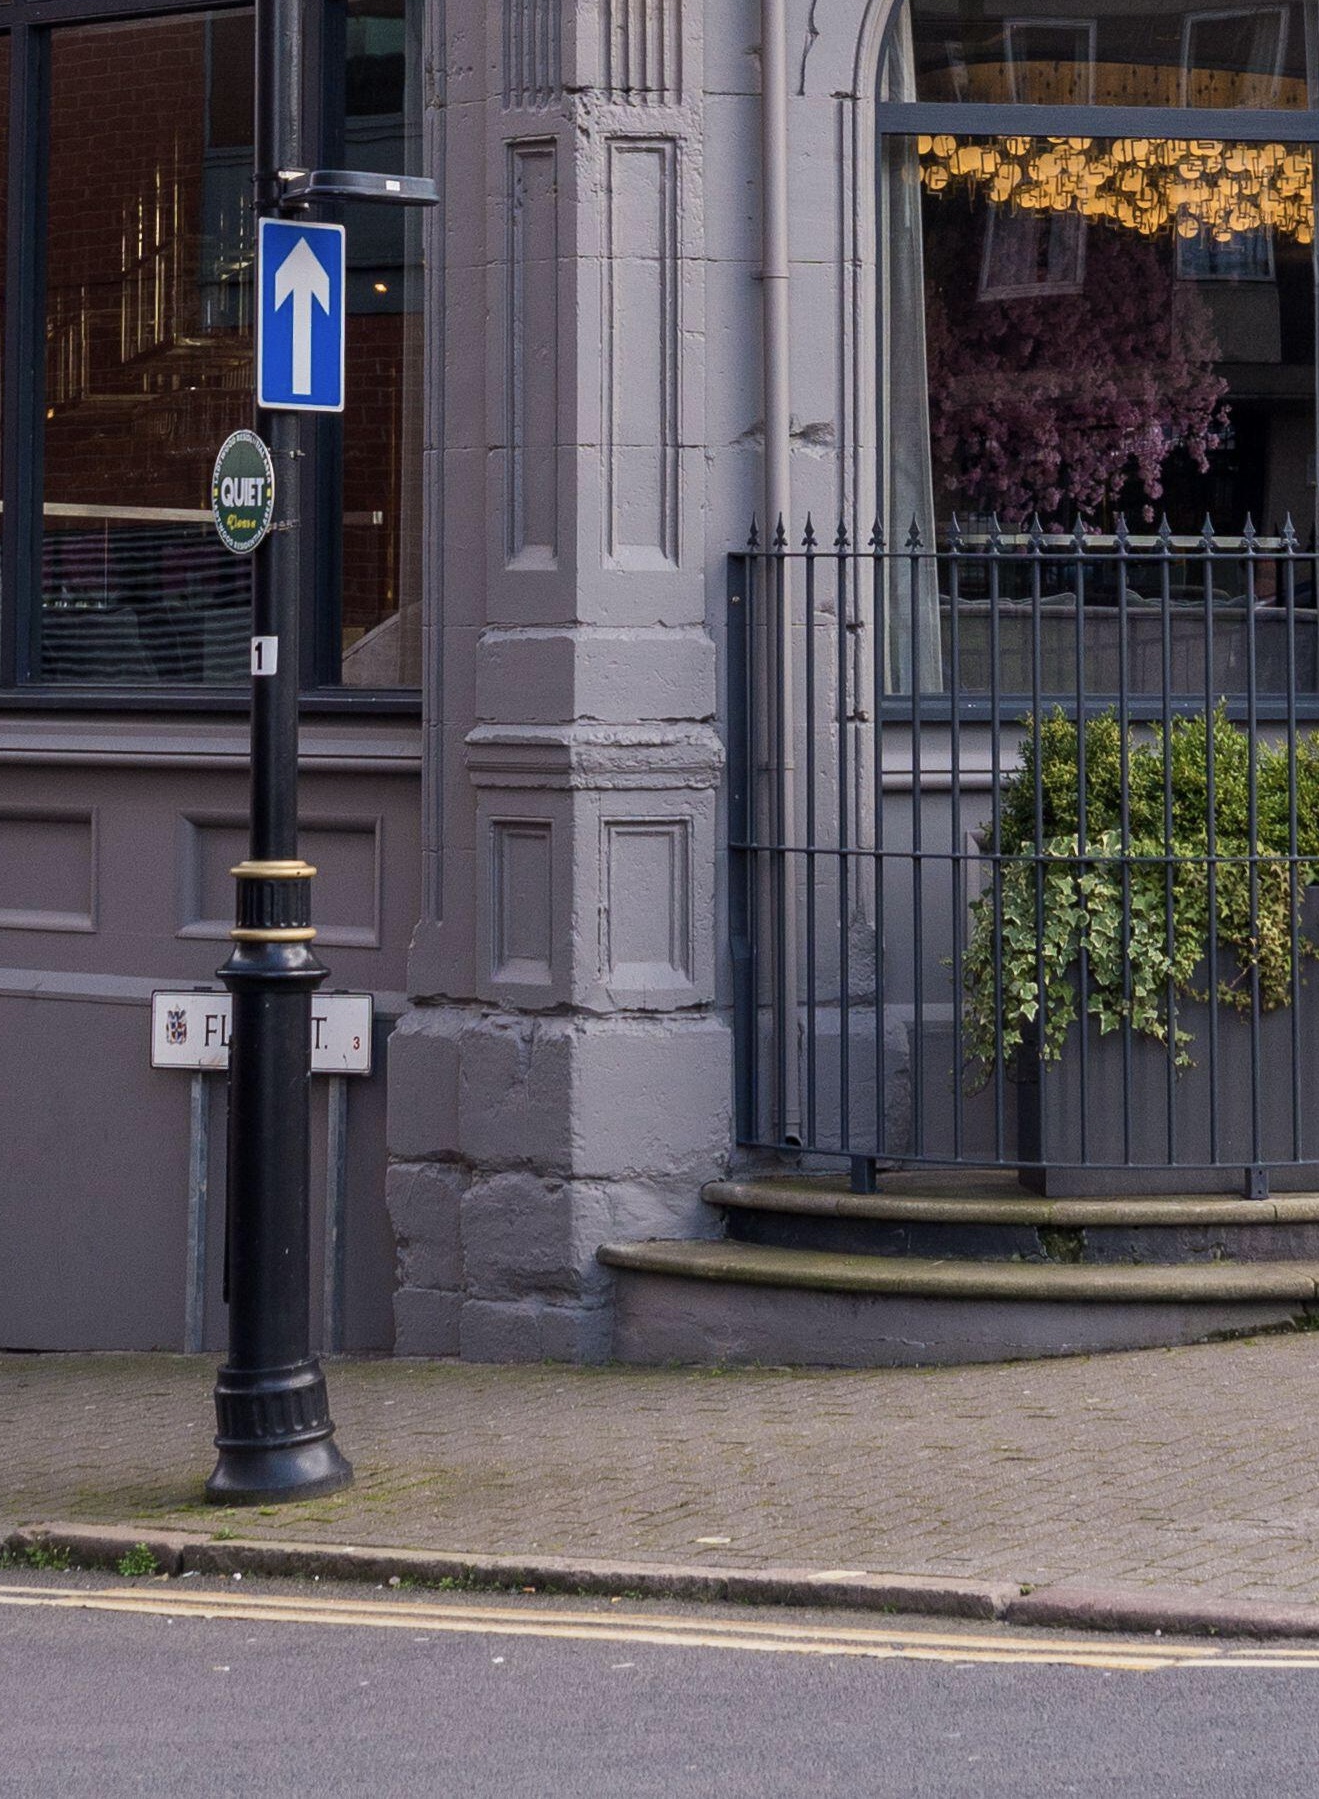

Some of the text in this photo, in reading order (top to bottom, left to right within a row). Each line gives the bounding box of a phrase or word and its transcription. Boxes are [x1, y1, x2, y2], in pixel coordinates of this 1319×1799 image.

[221, 476, 265, 508] QUIET
[255, 641, 262, 670] 1
[353, 1036, 361, 1050] 3
